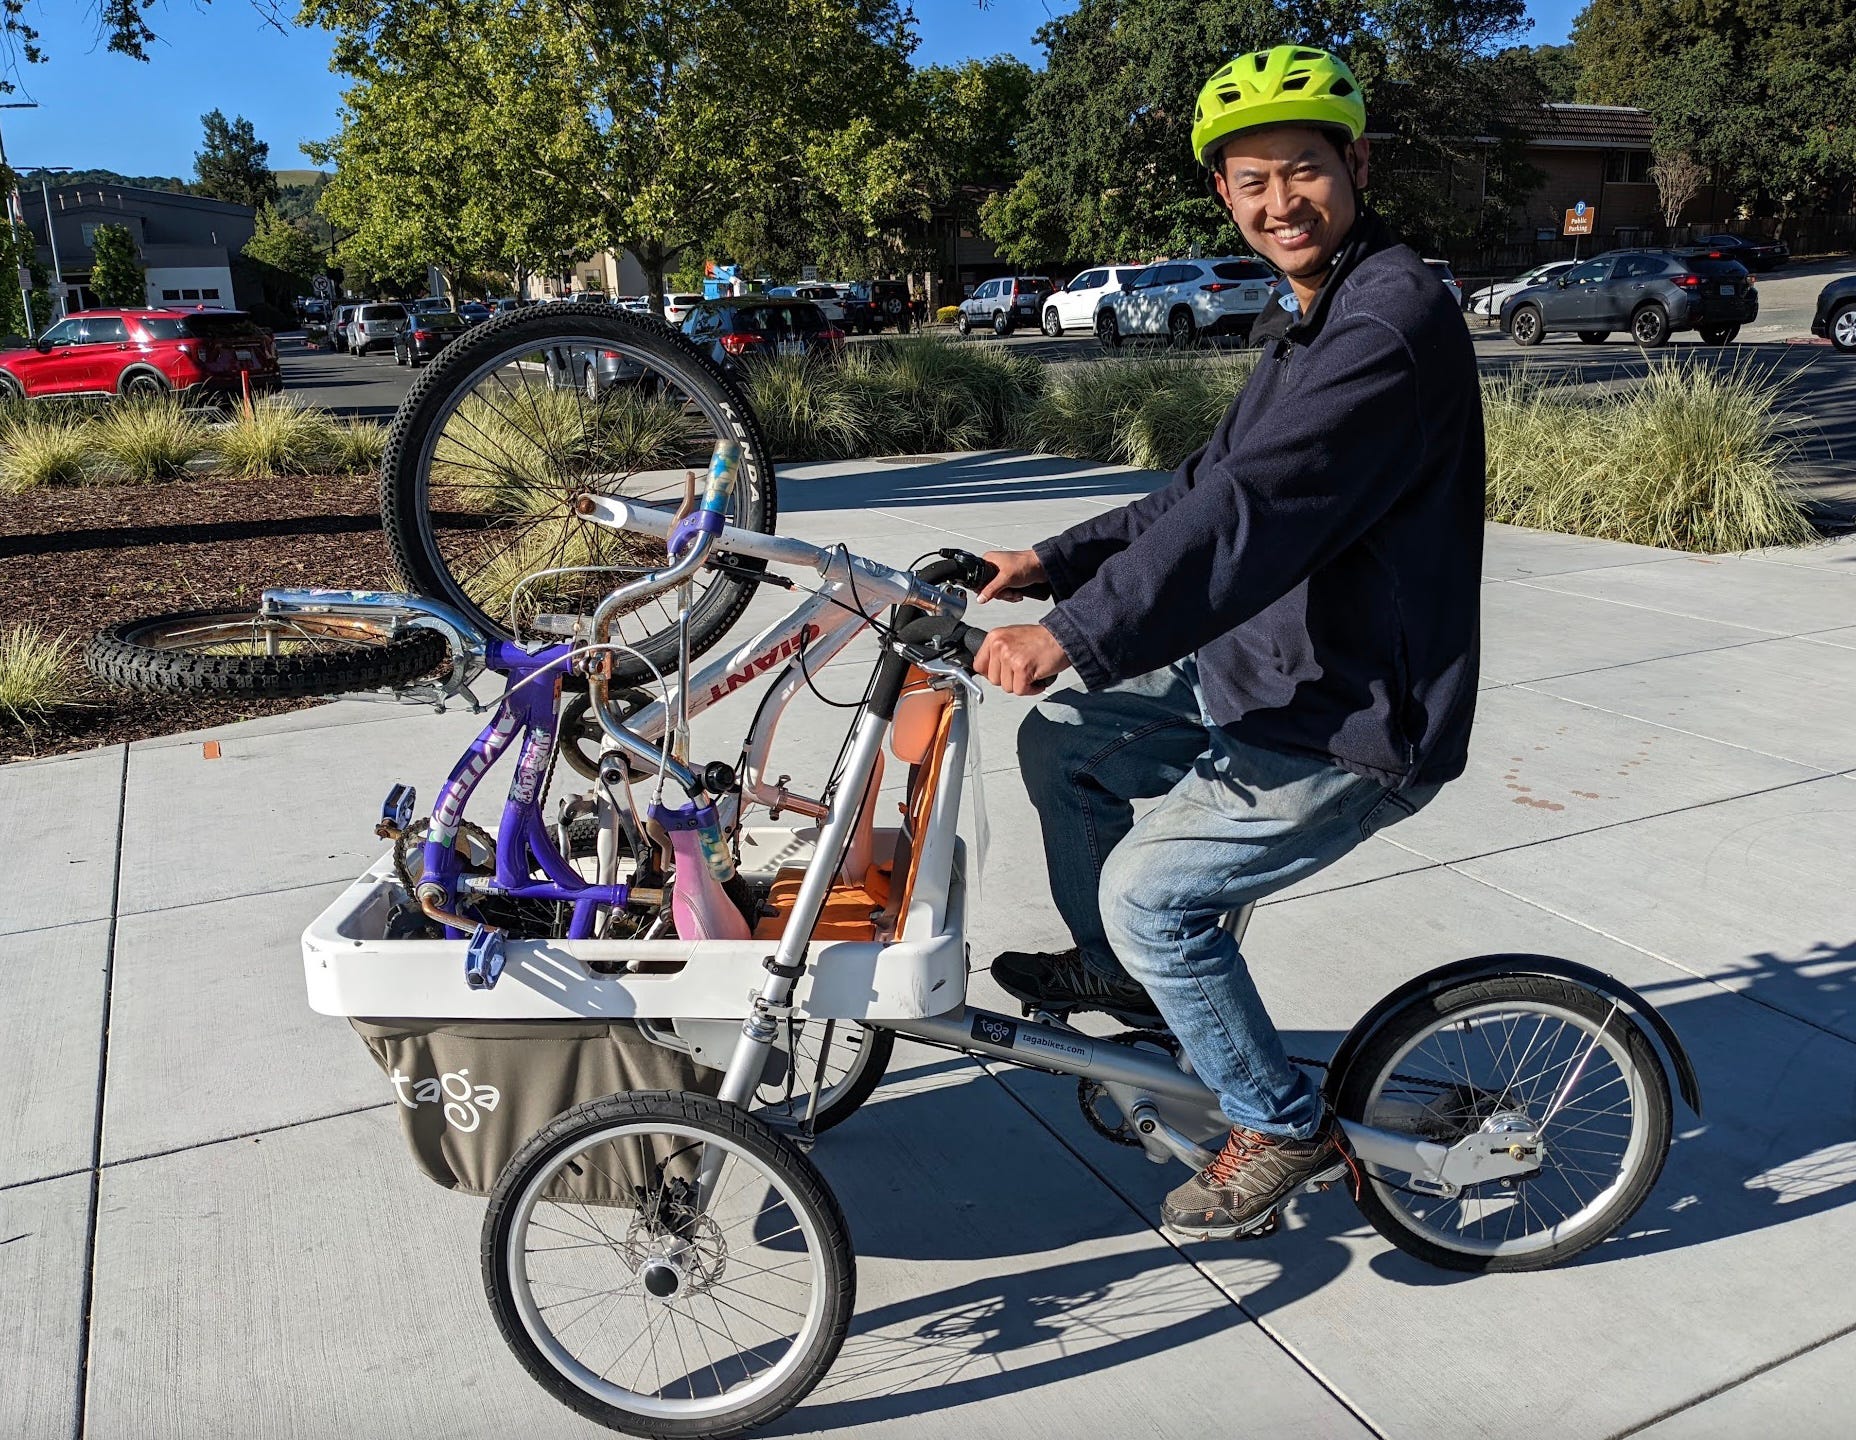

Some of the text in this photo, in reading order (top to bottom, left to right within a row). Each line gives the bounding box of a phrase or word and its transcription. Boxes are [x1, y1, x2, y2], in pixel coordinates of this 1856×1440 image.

[1571, 217, 1588, 225] Public
[719, 402, 760, 502] KENDA
[707, 624, 820, 706] GIANT
[980, 1018, 1085, 1056] taga tagabikes.com
[390, 1068, 501, 1133] taga
